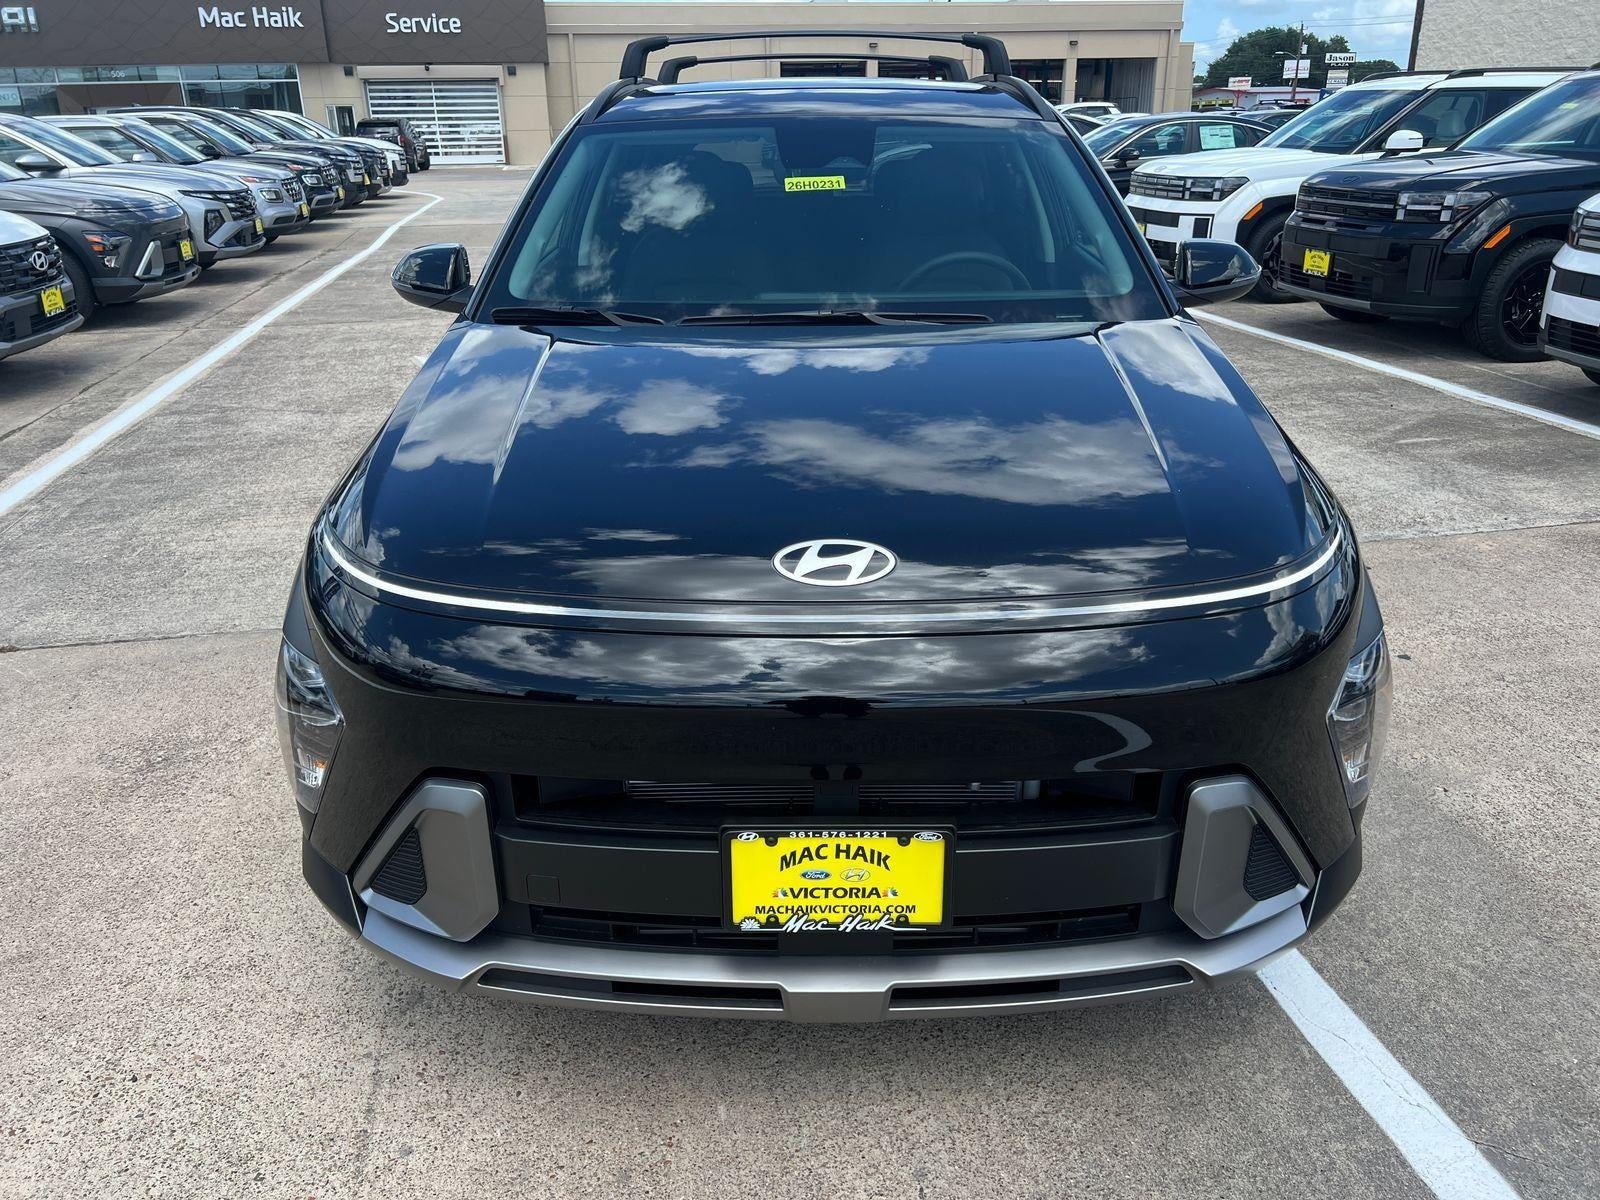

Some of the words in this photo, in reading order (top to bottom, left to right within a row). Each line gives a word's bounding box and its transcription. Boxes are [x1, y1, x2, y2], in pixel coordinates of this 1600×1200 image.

[198, 6, 247, 28] Mac
[251, 6, 305, 28] Haik
[384, 12, 462, 33] Service
[1327, 54, 1354, 62] Jason
[787, 179, 841, 190] 26H0231
[789, 831, 887, 839] 361-576-1221
[918, 833, 939, 841] Ford
[779, 843, 829, 872] MAC
[835, 843, 891, 871] HAIK
[804, 870, 828, 880] Ford
[788, 887, 882, 899] VICTORIA
[755, 904, 916, 915] MACHAIKVICTORIA.COM
[782, 914, 837, 933] Mac
[837, 914, 895, 933] Haik
